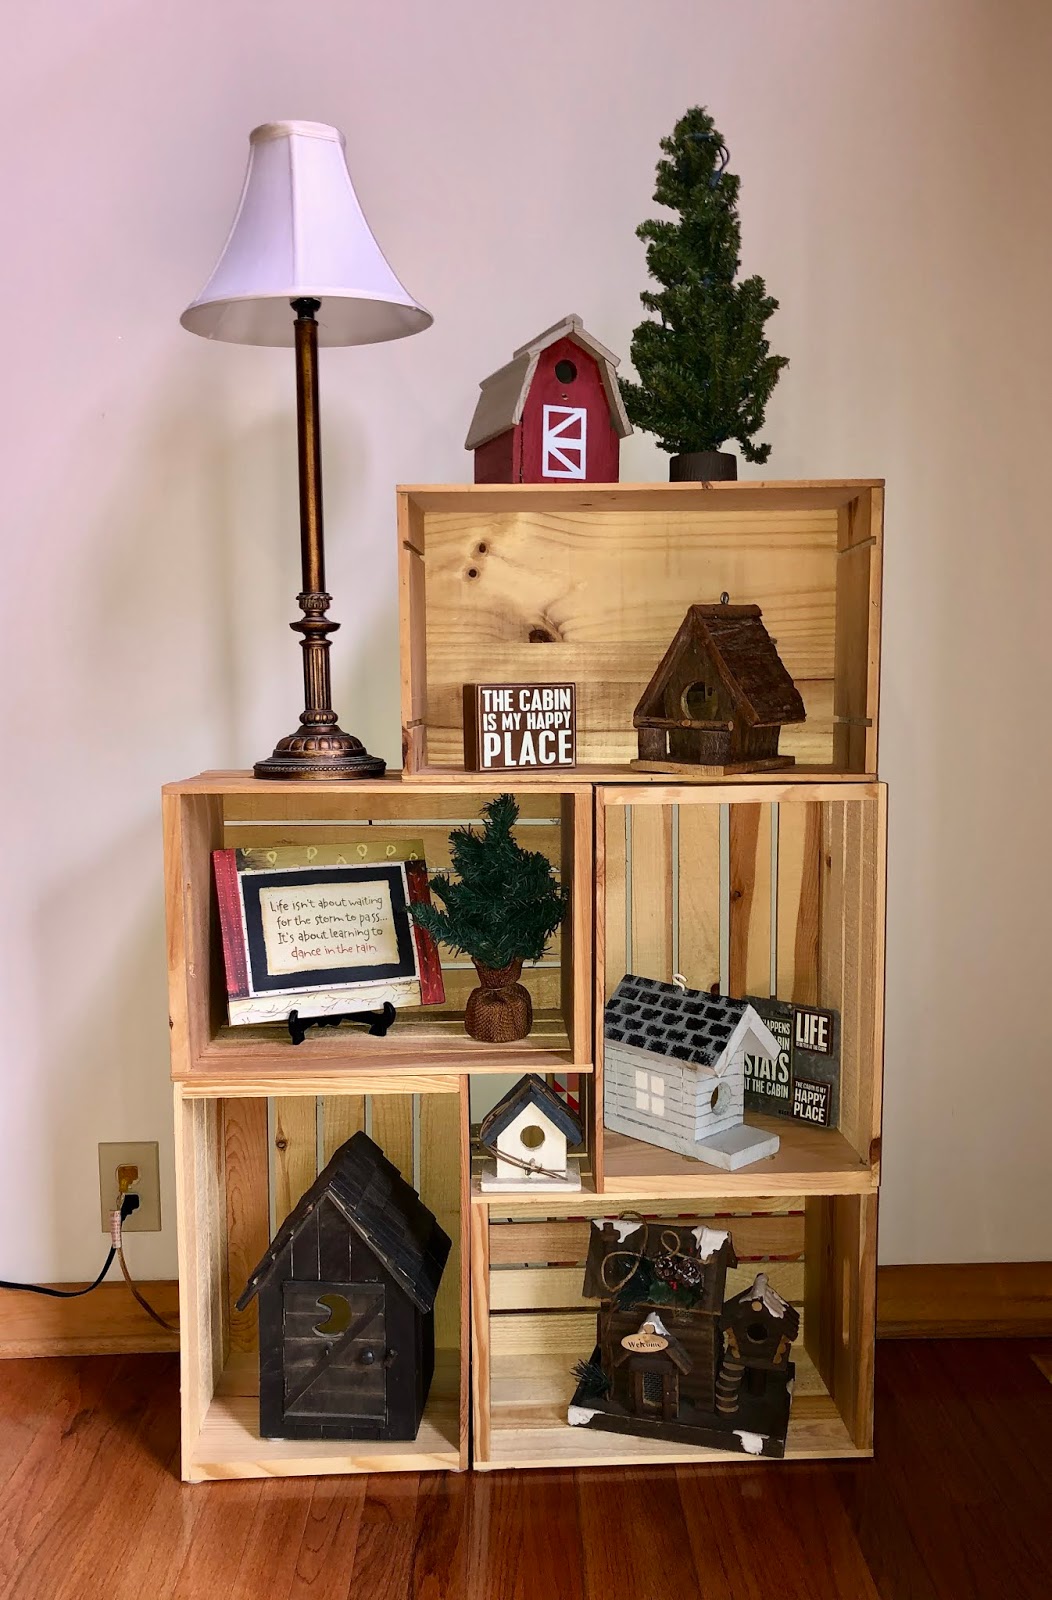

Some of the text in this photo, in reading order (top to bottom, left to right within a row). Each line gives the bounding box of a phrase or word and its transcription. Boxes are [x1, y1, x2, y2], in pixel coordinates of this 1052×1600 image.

[482, 688, 571, 712] THE CABIN
[483, 711, 571, 731] IS MY HAPPY
[483, 730, 572, 767] PLACE
[270, 897, 383, 914] Life isn't about waiting
[276, 912, 388, 929] for the storm to pass...
[277, 927, 383, 945] It's about learning to
[290, 944, 377, 960] dance in the rain
[796, 1012, 828, 1047] LIFE
[752, 1078, 765, 1094] THE
[766, 1081, 789, 1099] CABIN
[794, 1088, 826, 1108] HAPPY
[793, 1102, 825, 1123] PLACE
